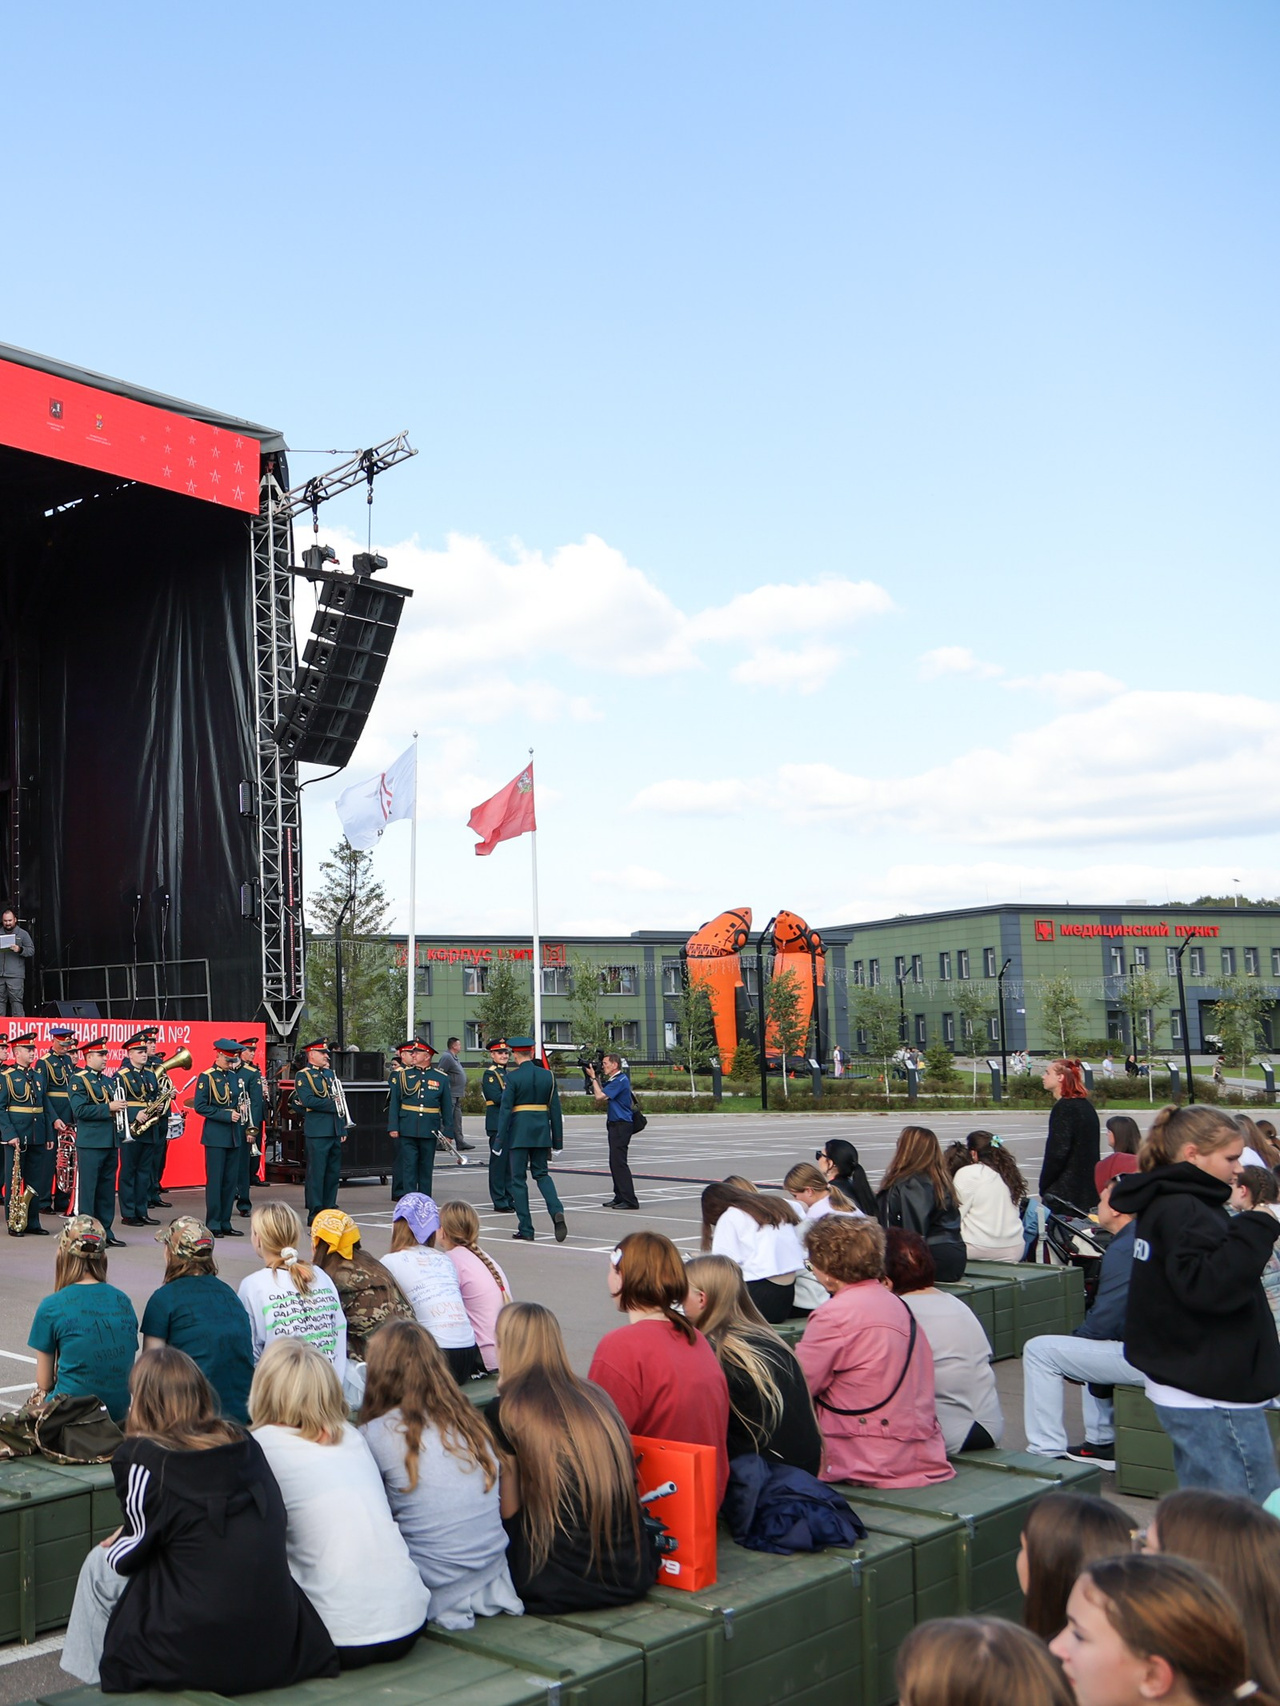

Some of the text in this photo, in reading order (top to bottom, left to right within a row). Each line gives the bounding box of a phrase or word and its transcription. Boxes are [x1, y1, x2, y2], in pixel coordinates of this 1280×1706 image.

[1060, 921, 1220, 940] медицинский пункт
[427, 948, 492, 965] корпус
[9, 1021, 99, 1043] ВЫСТАНАЯ
